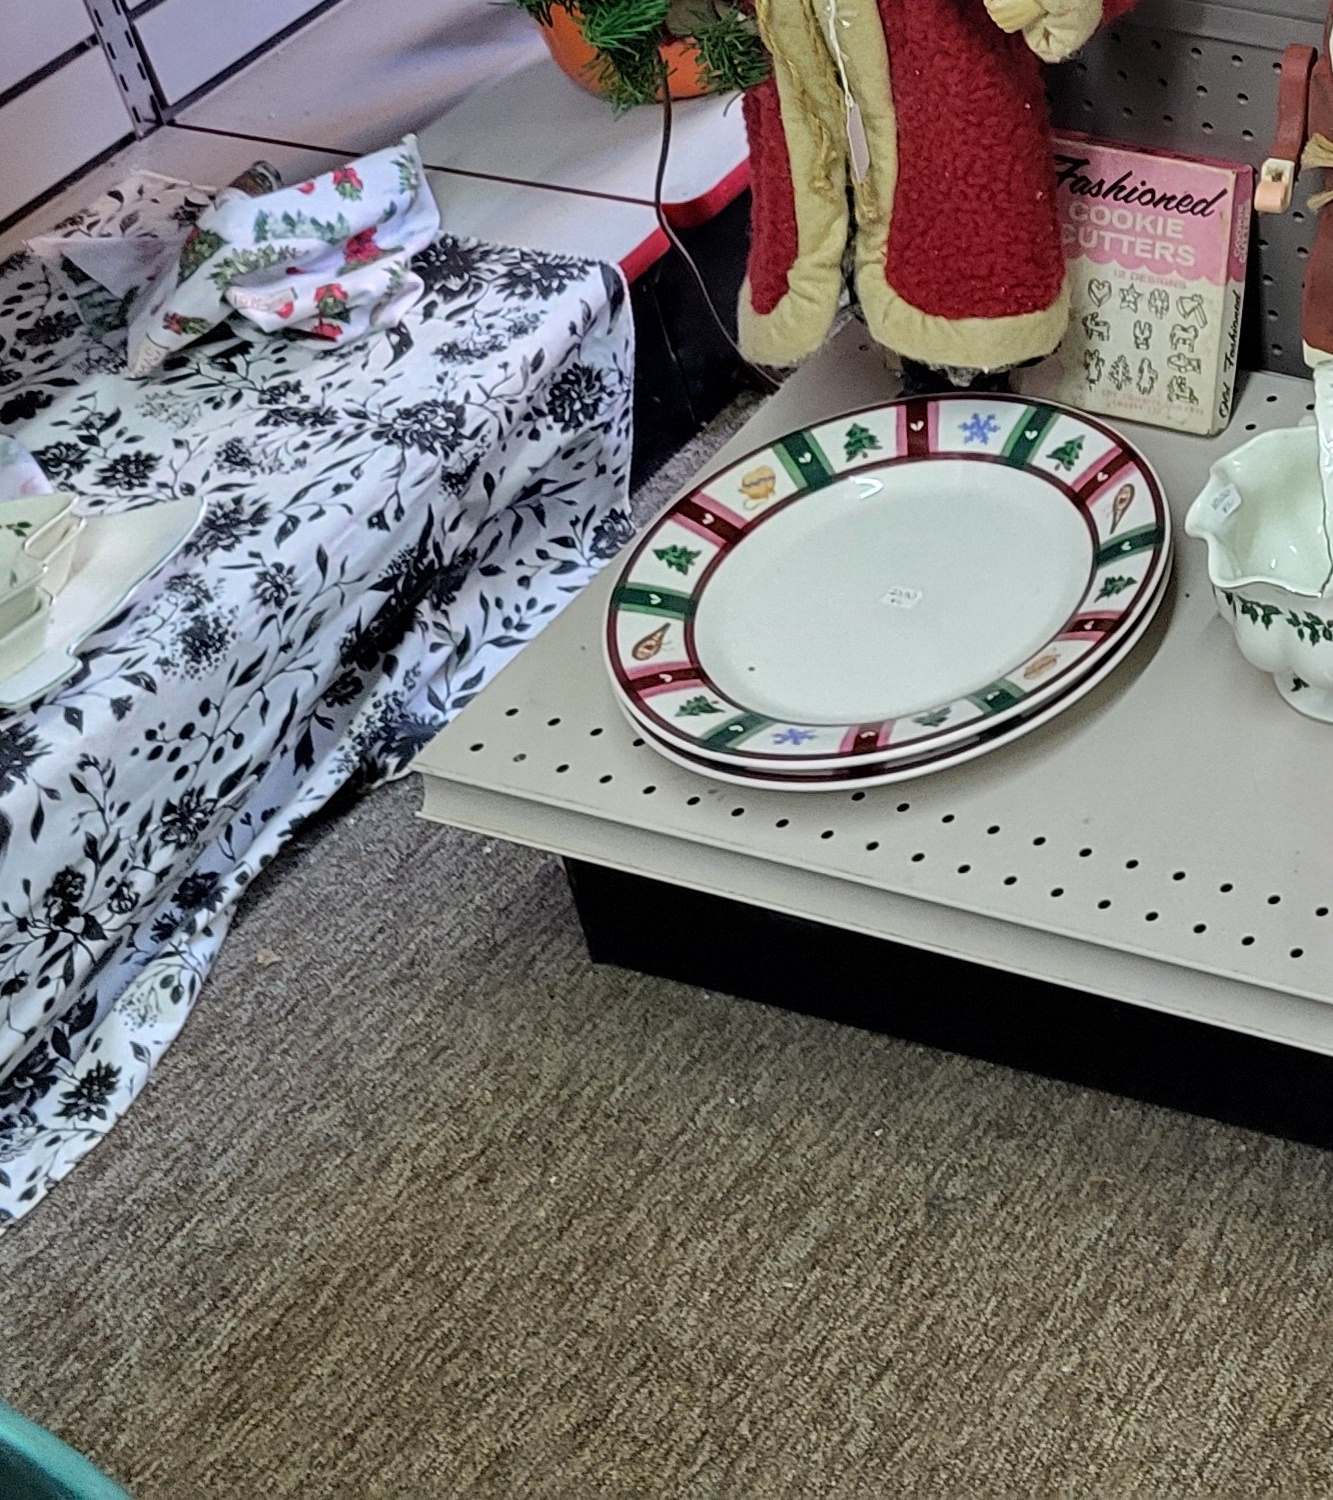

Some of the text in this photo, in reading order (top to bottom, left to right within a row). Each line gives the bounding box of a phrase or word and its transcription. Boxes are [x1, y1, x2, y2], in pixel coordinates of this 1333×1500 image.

[1053, 154, 1228, 218] Fashioned
[1069, 201, 1186, 239] COOKIE
[1061, 224, 1196, 268] CUTTERS
[1113, 269, 1188, 290] 12 DESIGNS
[1223, 289, 1241, 373] Fashioned
